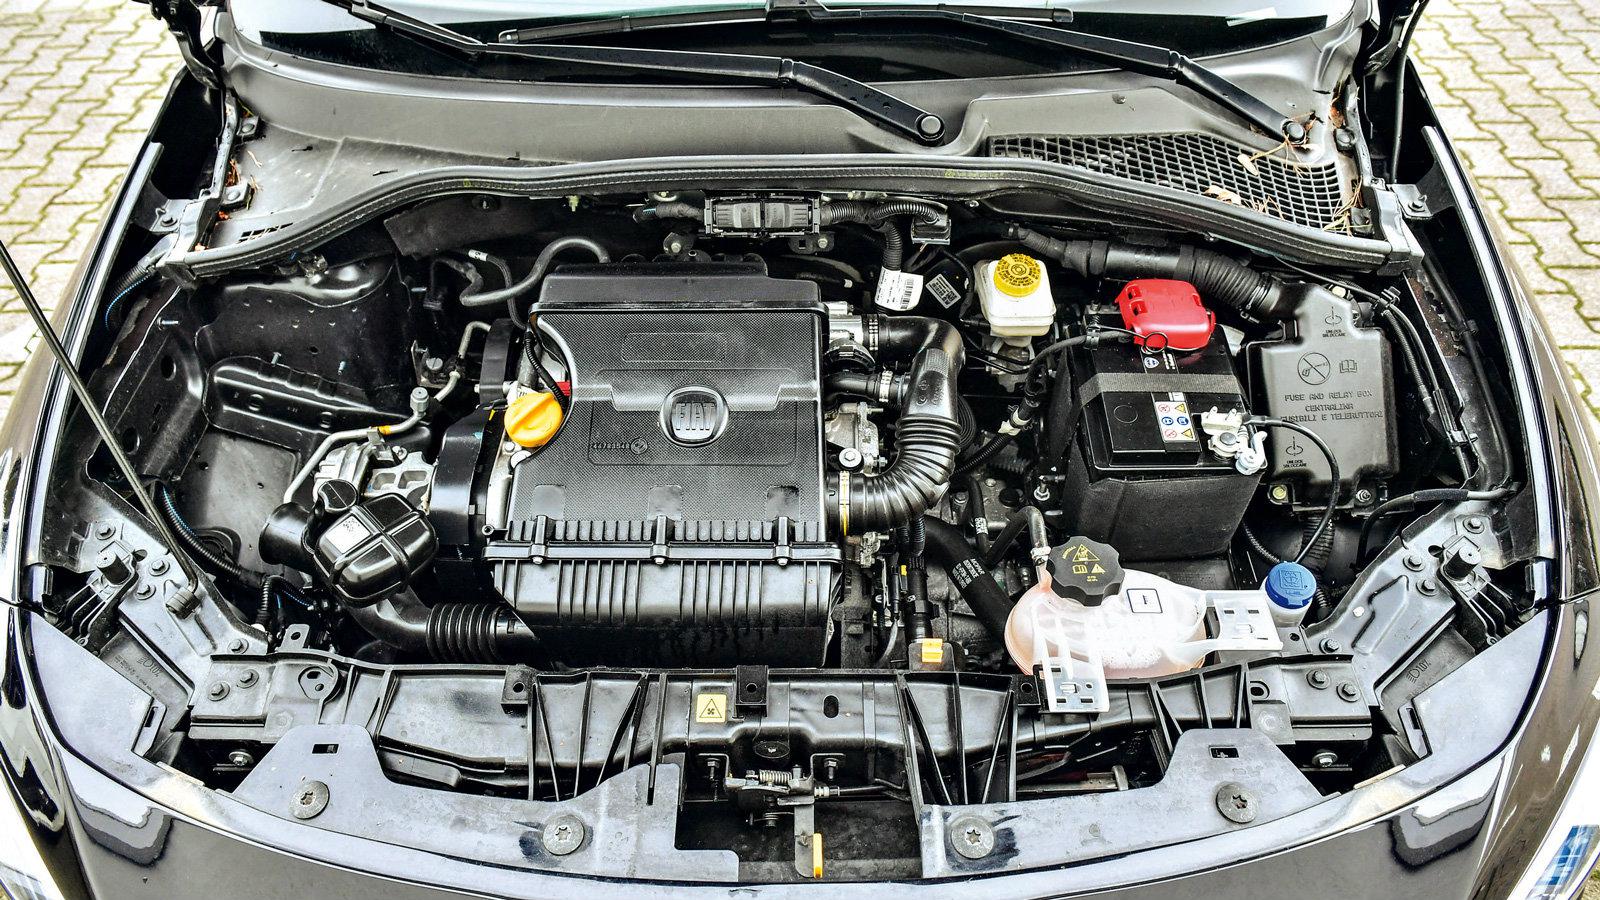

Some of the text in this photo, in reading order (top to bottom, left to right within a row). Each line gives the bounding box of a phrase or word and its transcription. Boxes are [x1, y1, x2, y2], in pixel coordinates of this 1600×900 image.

[1284, 390, 1373, 402] FUSE AND RELAY BOX
[1304, 403, 1354, 412] CENTRALINA
[671, 402, 716, 431] FIAT
[1330, 410, 1384, 421] TELERUTTORI
